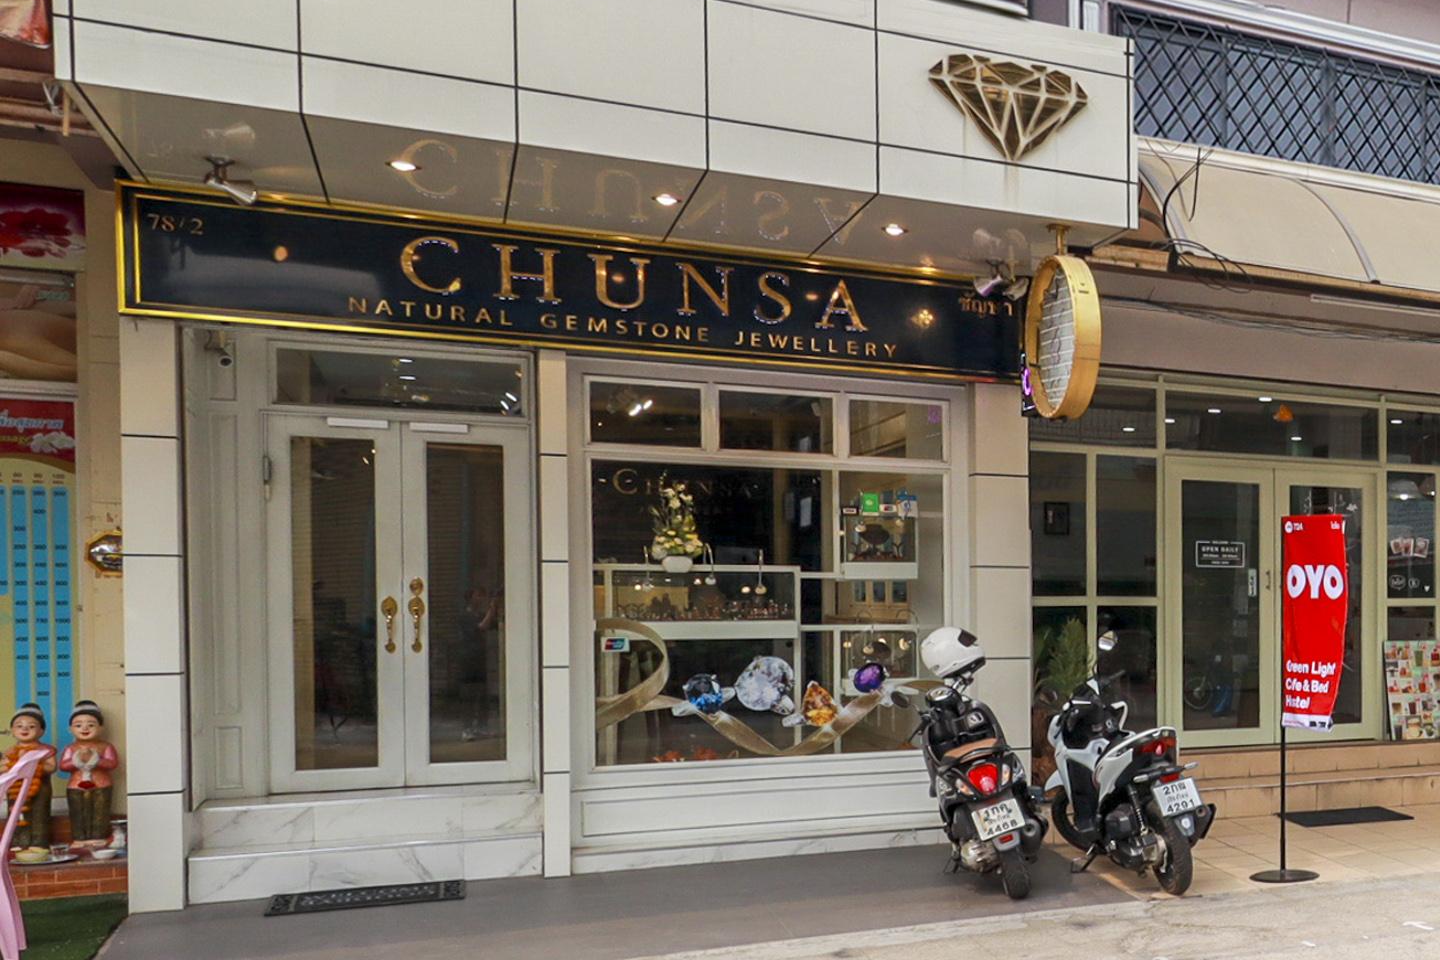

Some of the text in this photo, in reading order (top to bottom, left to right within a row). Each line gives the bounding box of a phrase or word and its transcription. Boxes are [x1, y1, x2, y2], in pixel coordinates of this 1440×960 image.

[400, 236, 869, 334] CHUNSA
[349, 296, 897, 359] NATURAL GEMSTONE JEWELLERY
[1287, 564, 1344, 600] OYO
[1285, 678, 1302, 692] Cfe
